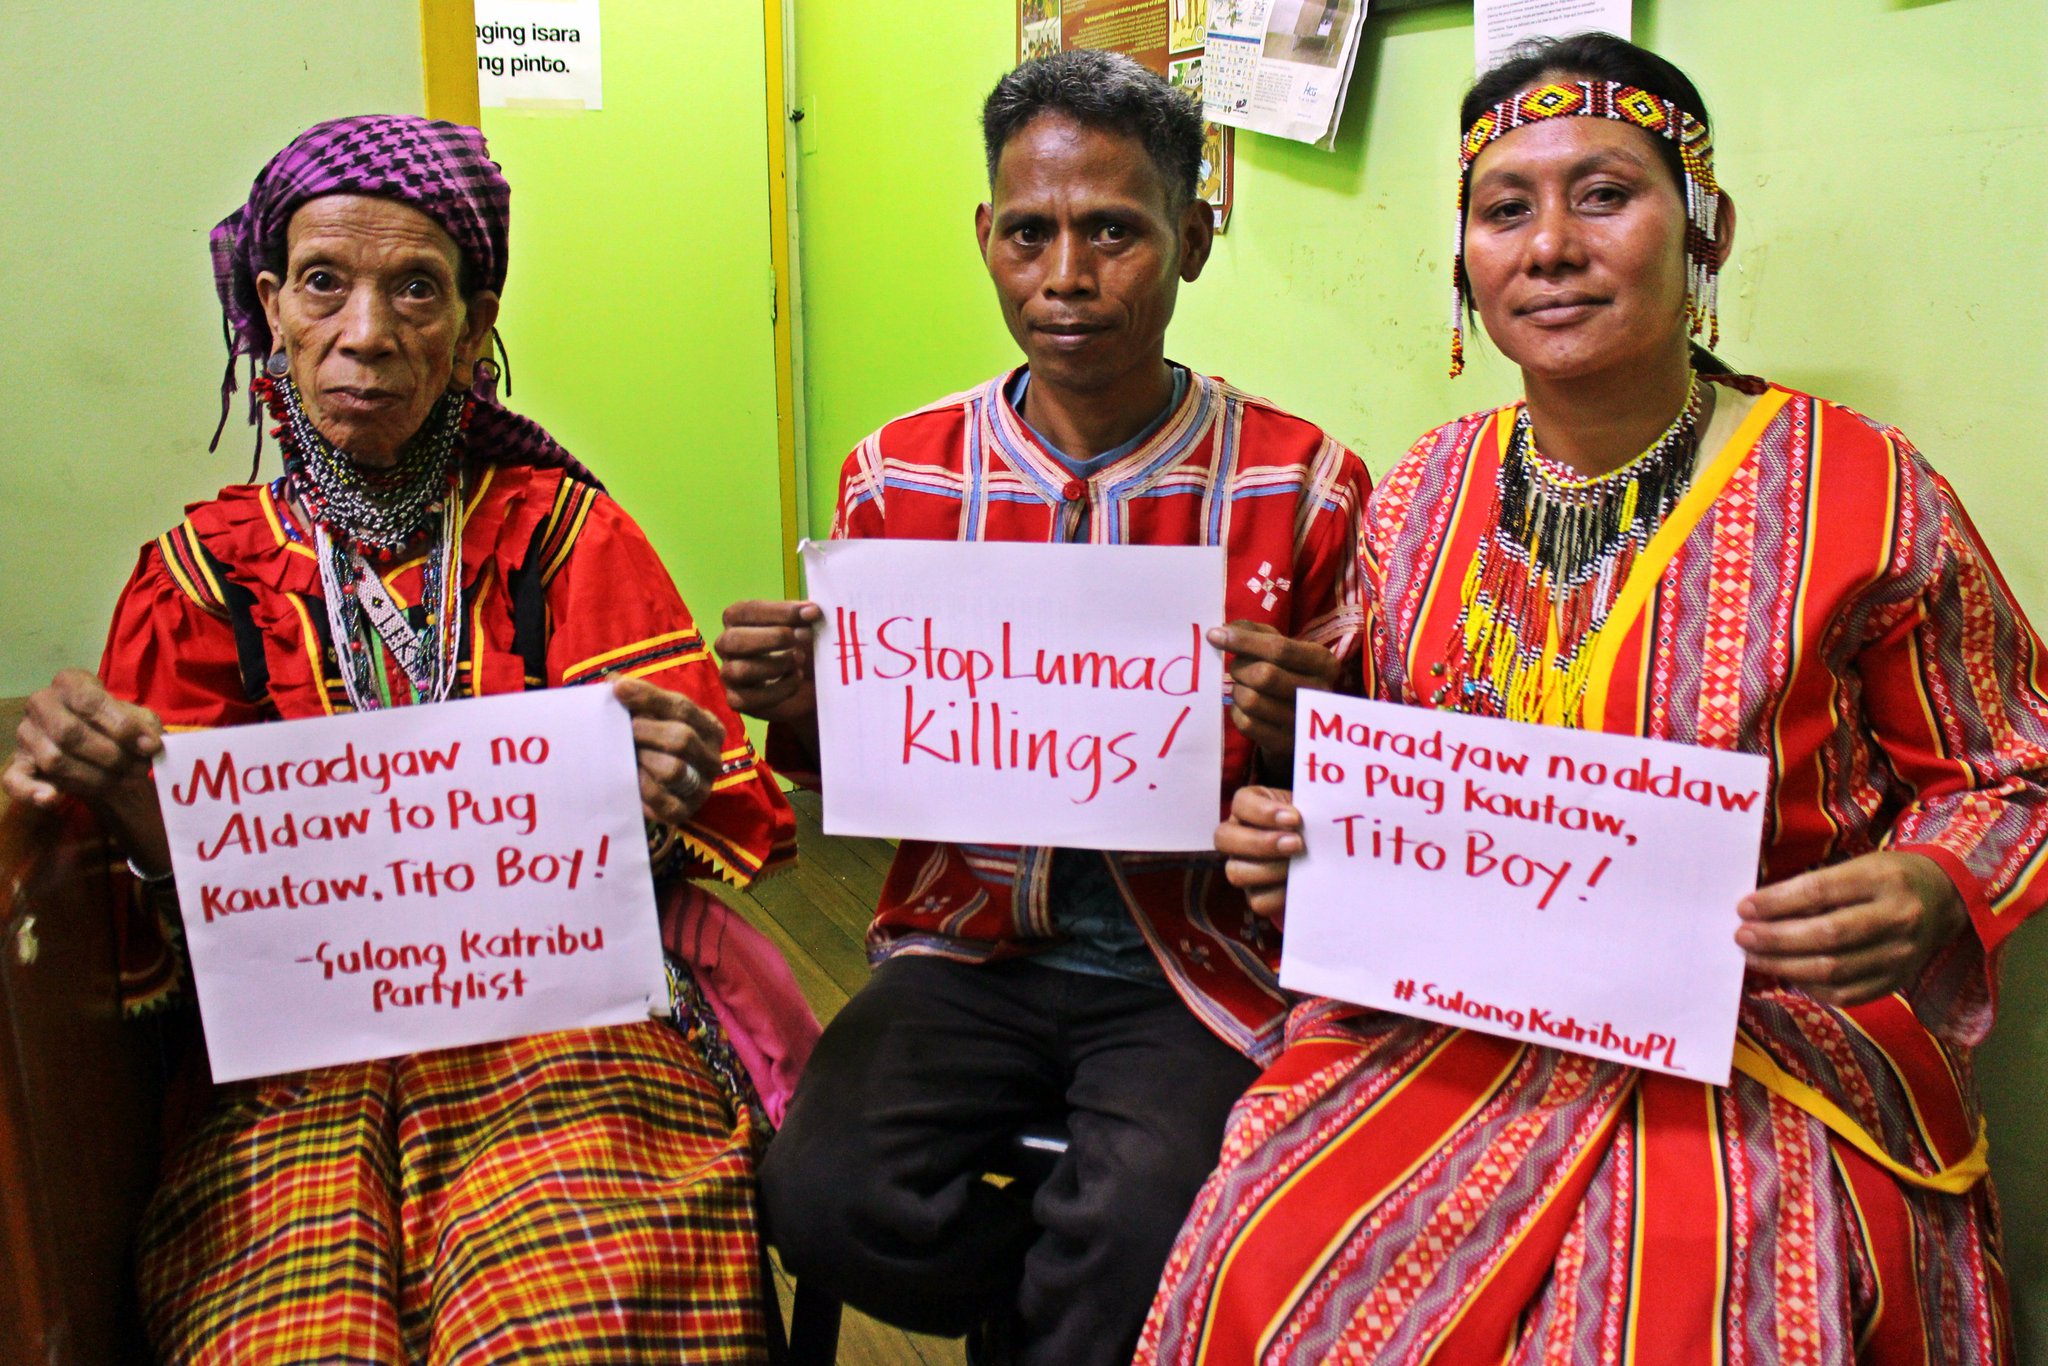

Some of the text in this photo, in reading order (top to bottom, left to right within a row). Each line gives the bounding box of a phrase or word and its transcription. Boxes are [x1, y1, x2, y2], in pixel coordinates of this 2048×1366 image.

[532, 23, 580, 43] isara
[511, 54, 570, 77] pinto.
[172, 735, 550, 806] Maradyaw no
[1308, 709, 1529, 777] Maradyaw
[1305, 752, 1345, 784] to
[1364, 764, 1445, 814] Pug
[197, 789, 538, 862] Aldaw to Pug
[1331, 813, 1446, 871] Tito
[386, 859, 475, 897] Tito
[373, 969, 528, 1012] Partylist
